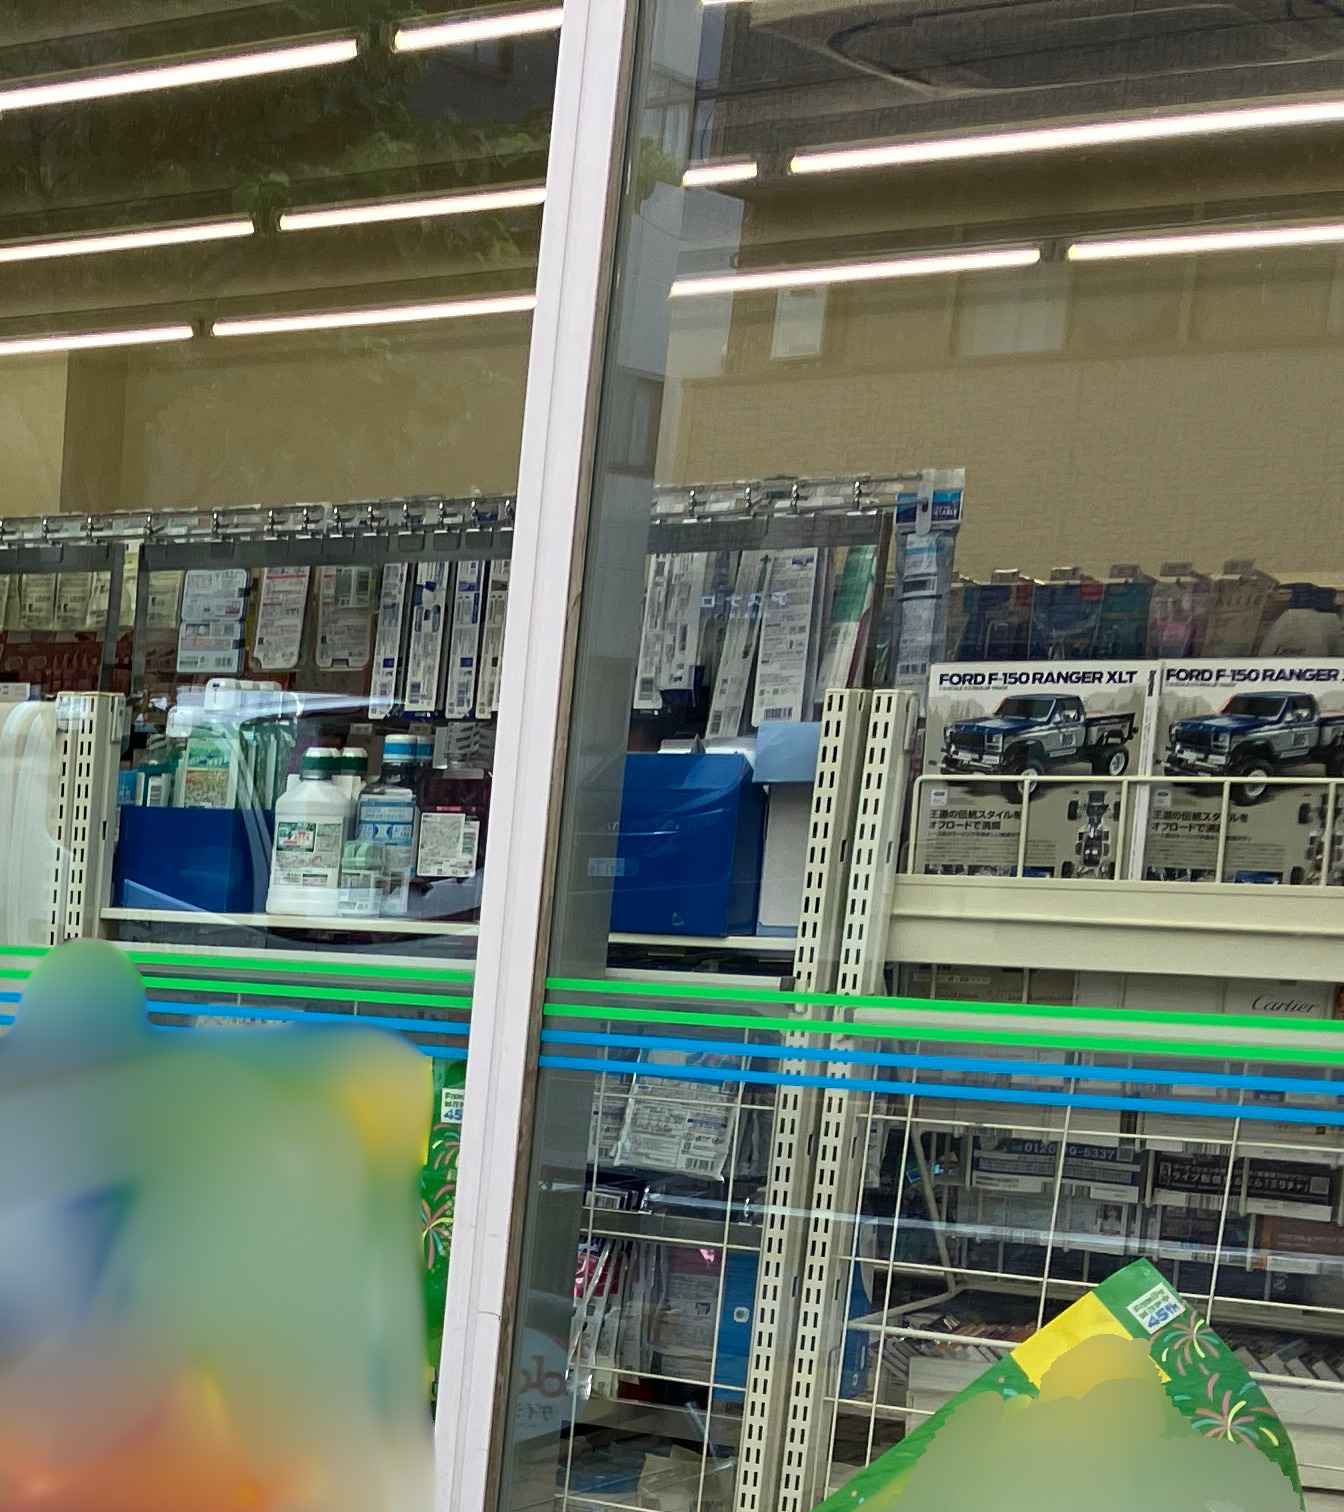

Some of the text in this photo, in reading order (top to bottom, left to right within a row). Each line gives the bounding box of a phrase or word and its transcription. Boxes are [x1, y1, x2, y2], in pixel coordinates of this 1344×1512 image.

[939, 670, 1138, 686] FORD F-150 RANGER XLT
[1165, 668, 1339, 682] FORD F-150 RANGER
[1250, 993, 1316, 1014] Cartier
